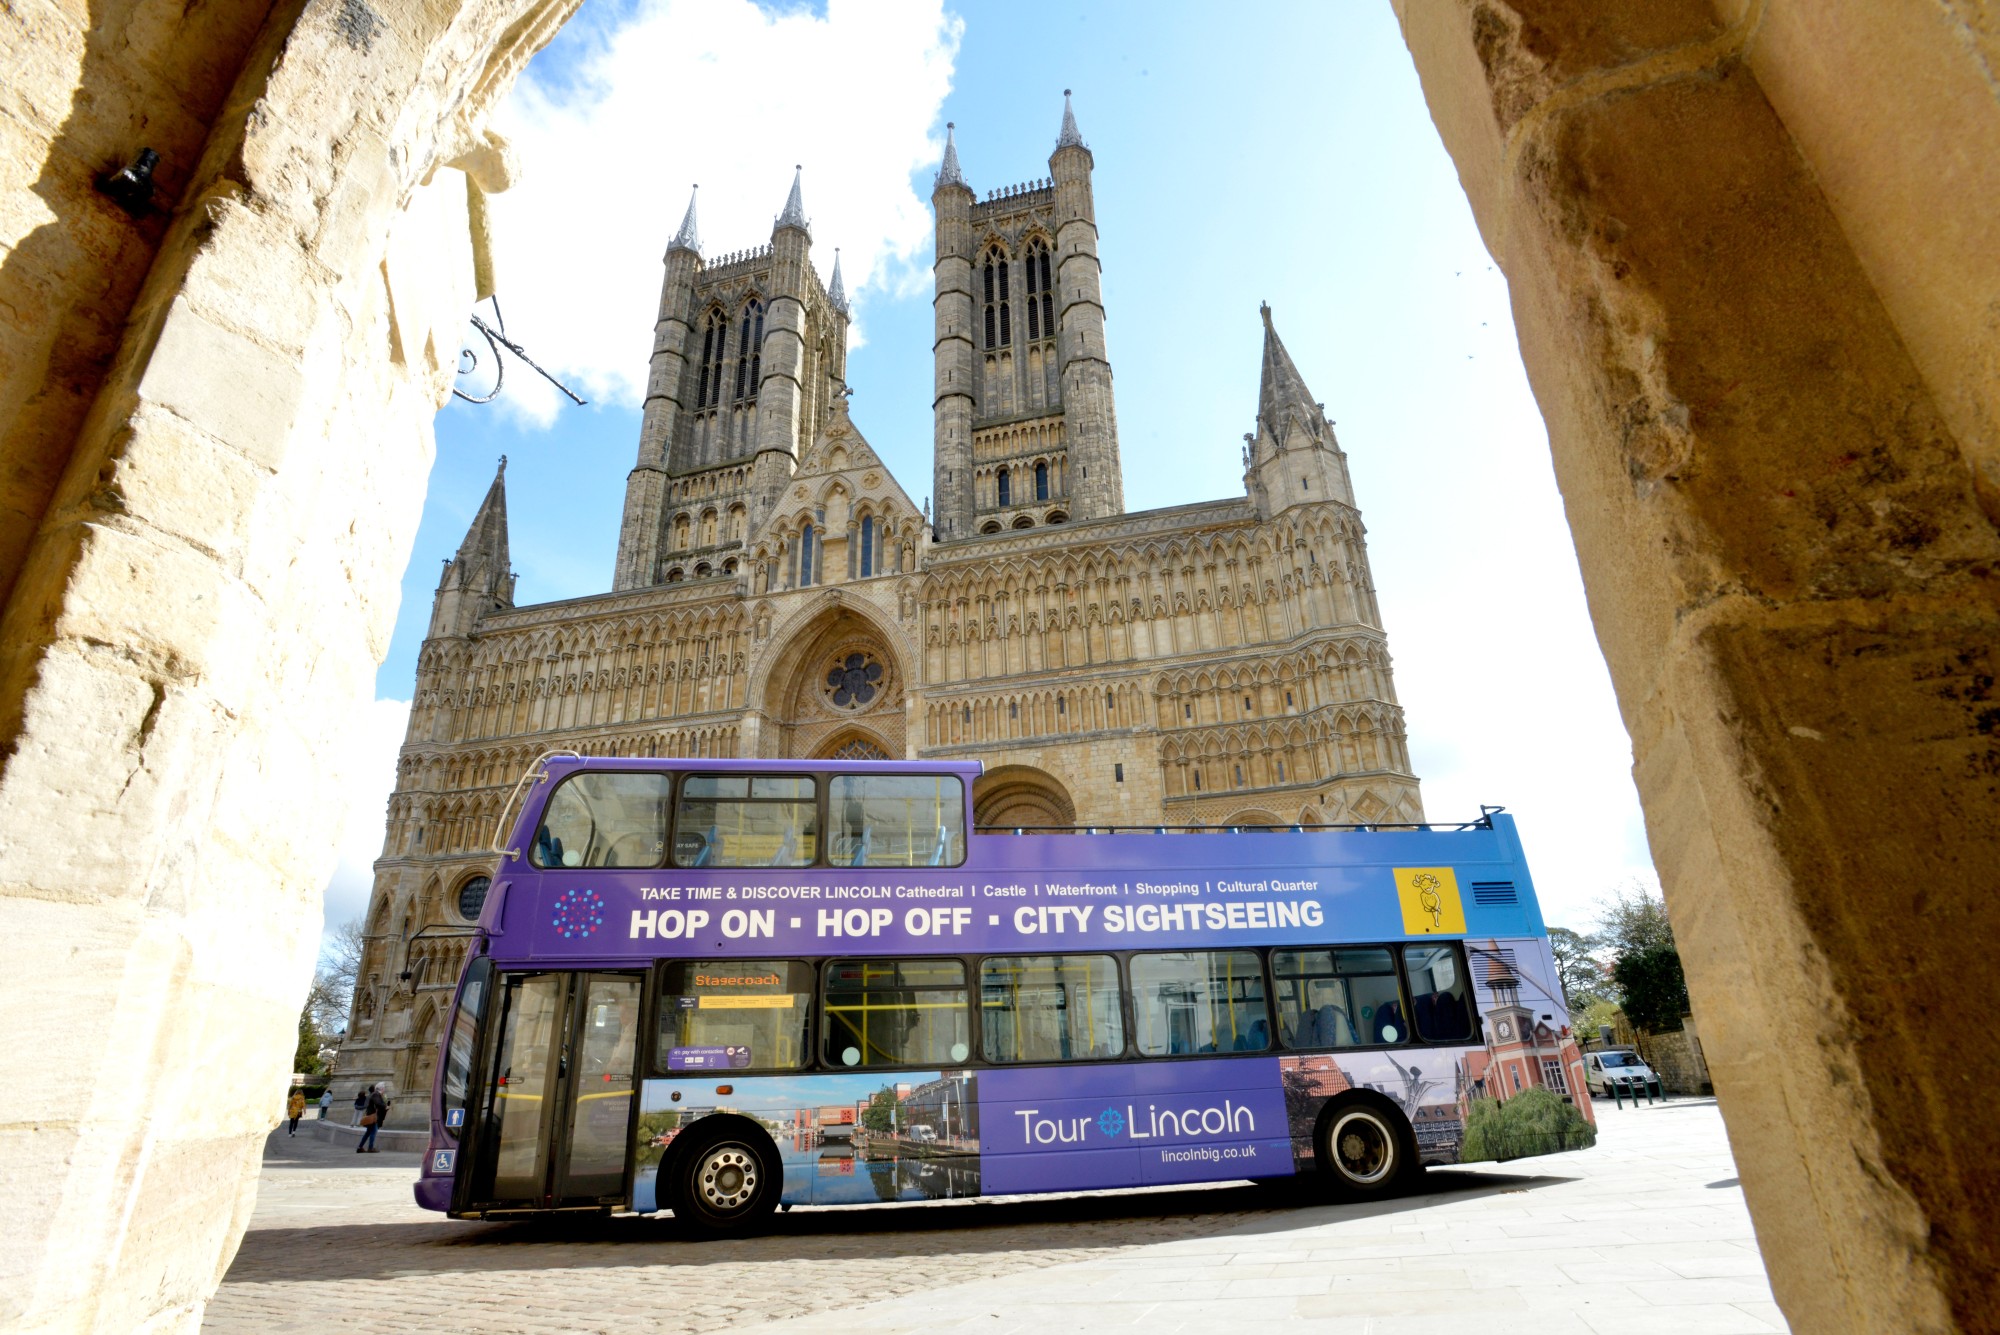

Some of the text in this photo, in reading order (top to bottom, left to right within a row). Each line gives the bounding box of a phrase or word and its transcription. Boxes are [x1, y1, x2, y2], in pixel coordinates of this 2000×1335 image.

[641, 880, 1318, 900] TAKE TIME & DISCOVER LINCOLN Cathedral Castle Waterfront Shopping Cultural Quarter
[630, 900, 1324, 939] HOP ON HOP OFF CITY SIGHTSEEING
[695, 973, 780, 986] Stagecoach
[1015, 1099, 1255, 1144] Tour Lincoln
[1161, 1145, 1256, 1163] lincolnbig.co.uk
